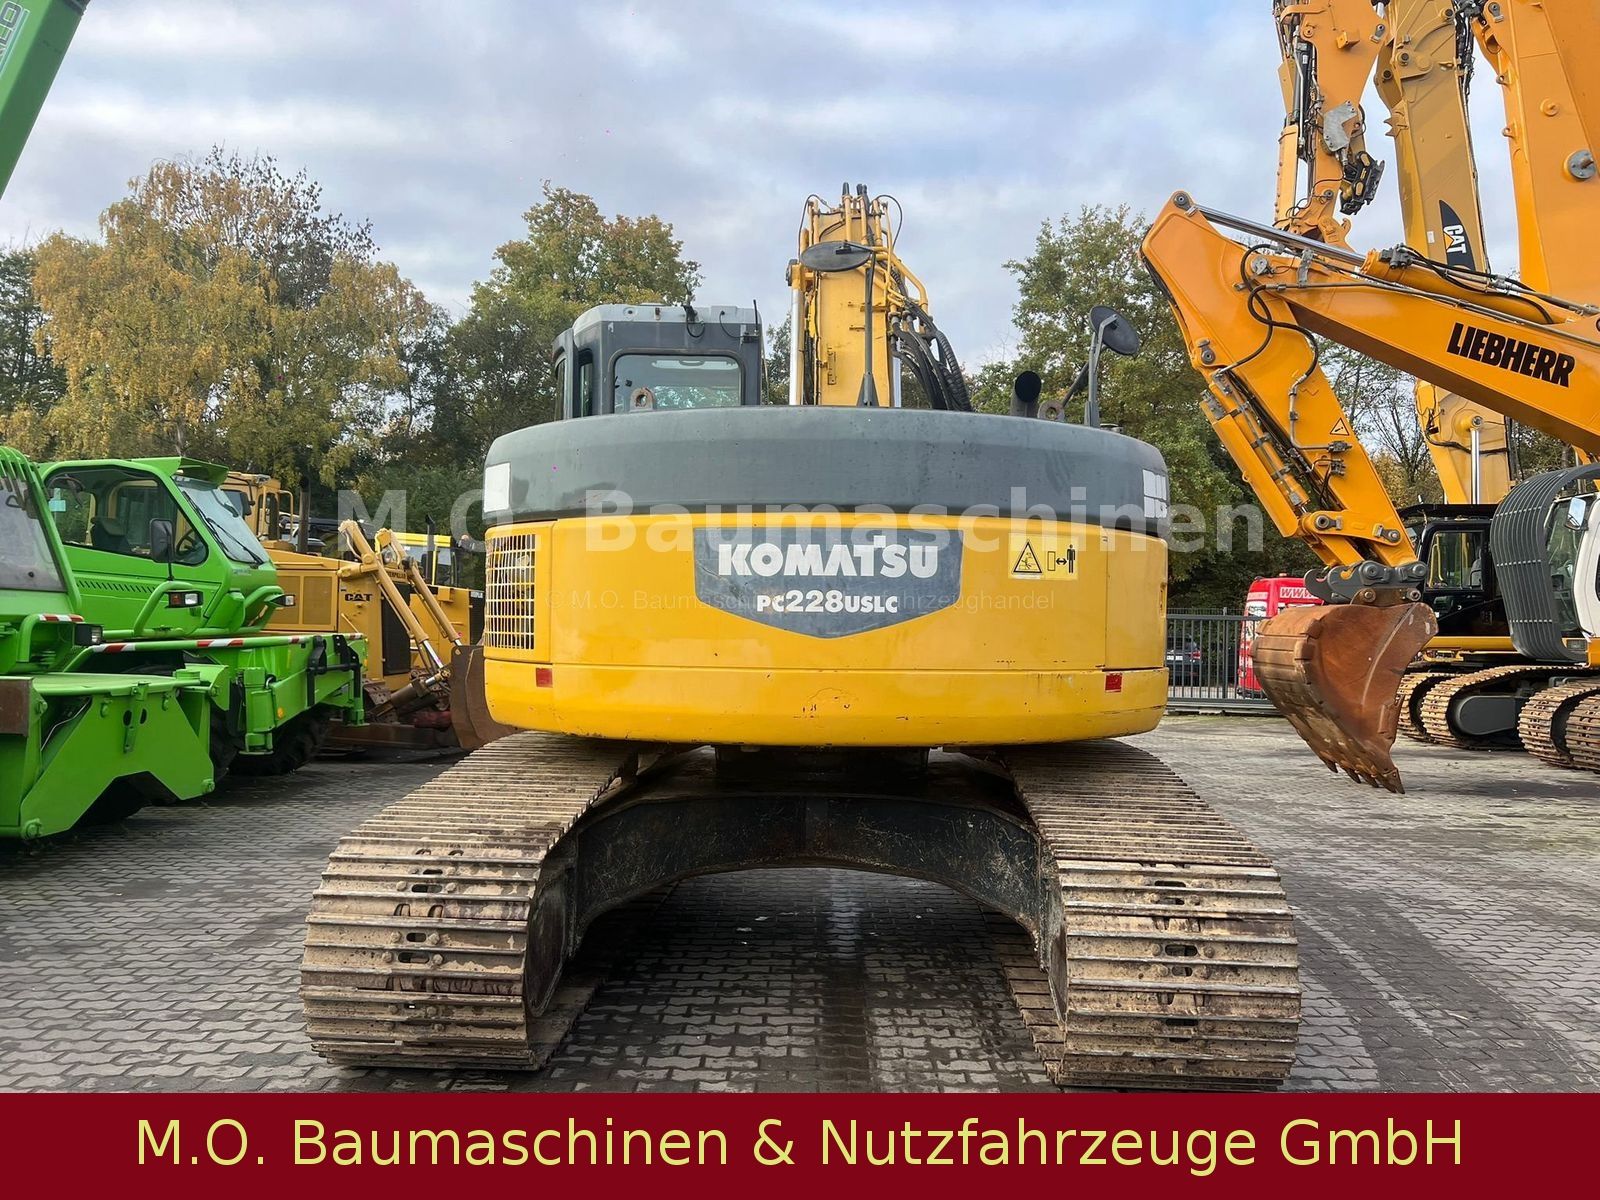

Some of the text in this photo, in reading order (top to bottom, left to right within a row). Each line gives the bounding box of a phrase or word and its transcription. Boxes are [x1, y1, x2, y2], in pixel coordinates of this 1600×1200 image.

[1443, 225, 1467, 253] CAT
[1446, 322, 1575, 388] LIEBHERR
[718, 535, 939, 578] KOMATSU
[345, 593, 373, 602] CAT
[757, 589, 898, 613] PC228USLC
